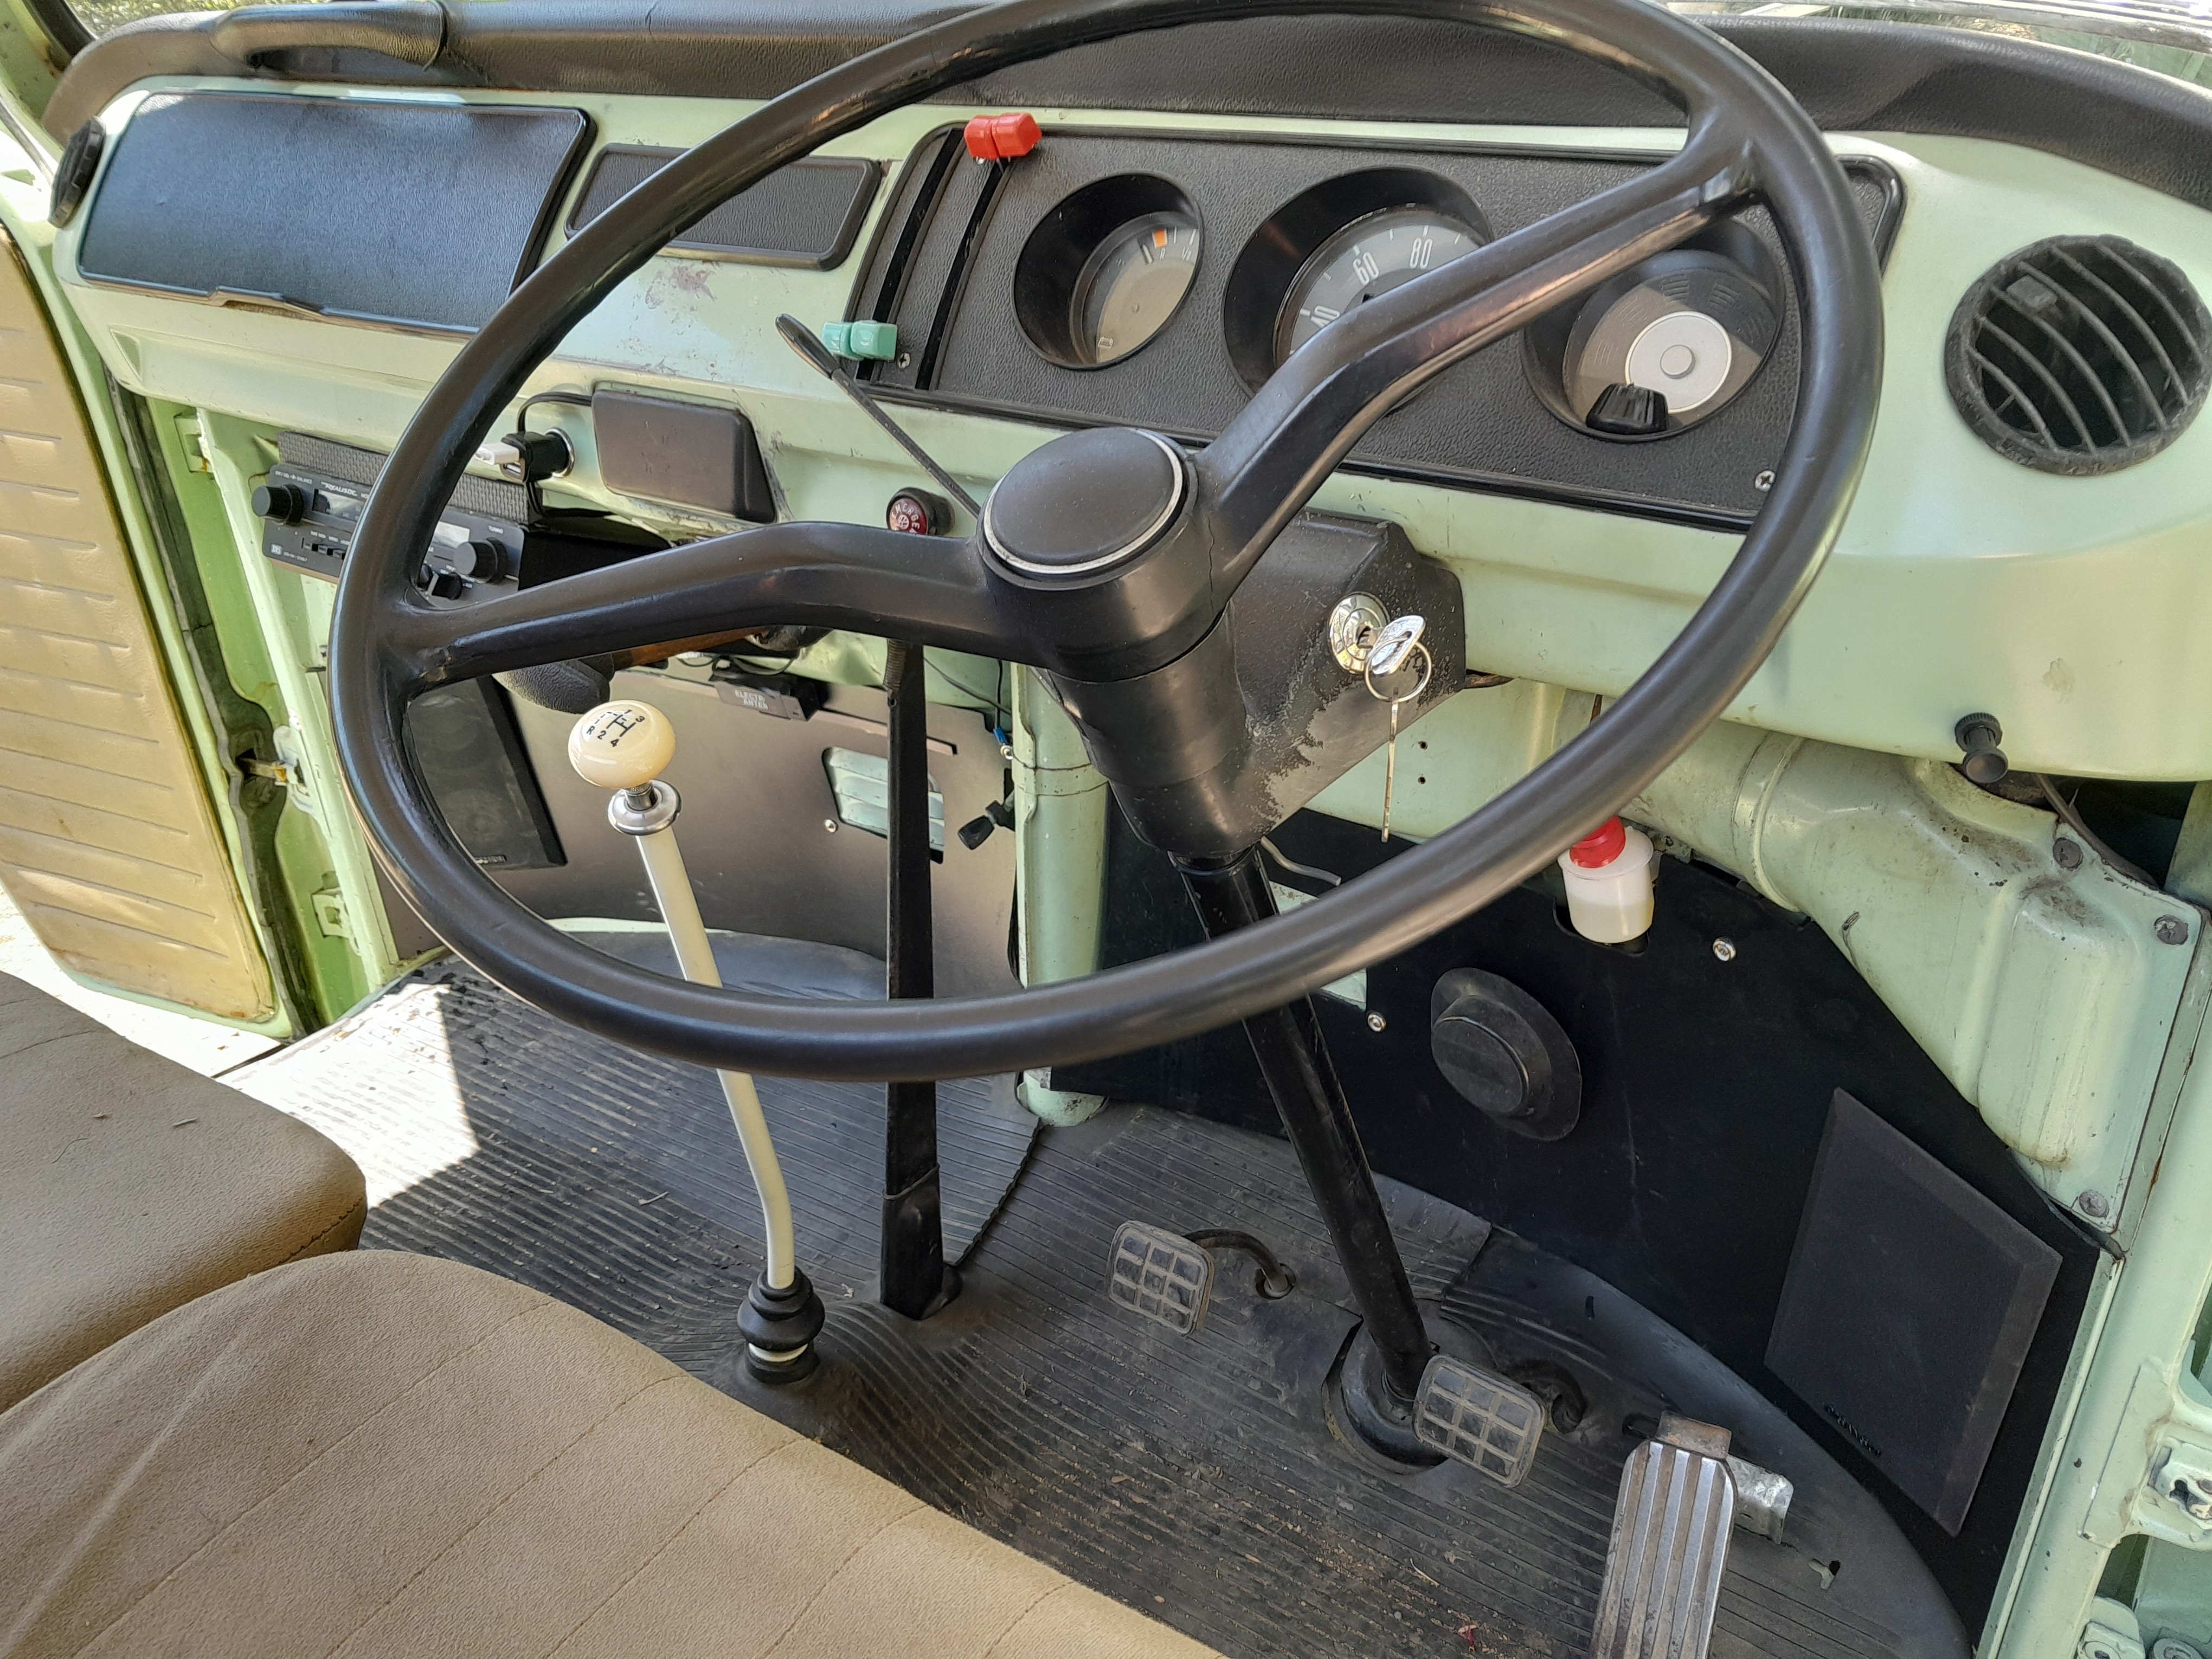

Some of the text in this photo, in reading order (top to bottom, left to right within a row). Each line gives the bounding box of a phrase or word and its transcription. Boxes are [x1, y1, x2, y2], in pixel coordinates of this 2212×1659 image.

[1410, 237, 1433, 269] 80
[1353, 251, 1379, 286] 60
[891, 503, 921, 533] EMERGE
[586, 725, 595, 735] R
[597, 730, 607, 740] 2
[610, 738, 619, 747] 4
